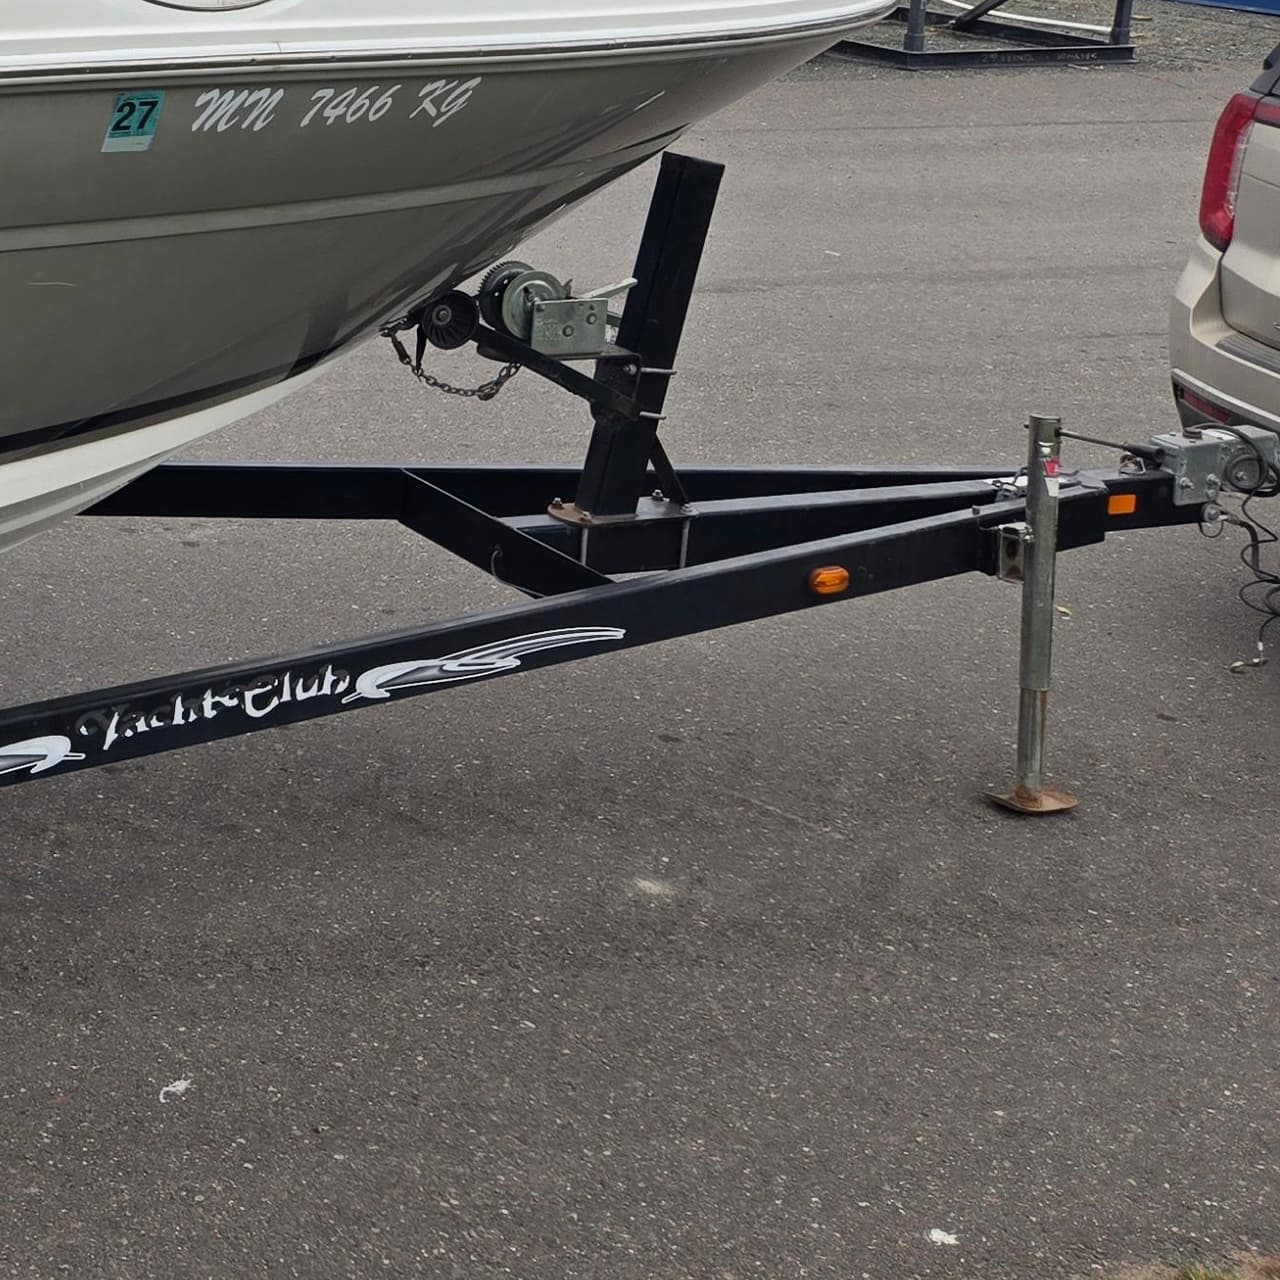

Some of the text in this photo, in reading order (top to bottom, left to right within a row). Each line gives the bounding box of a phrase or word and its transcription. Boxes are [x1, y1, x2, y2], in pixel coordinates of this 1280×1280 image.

[111, 100, 159, 131] 27
[192, 76, 482, 132] MN 7466 KG
[75, 663, 351, 751] Yacht Club
